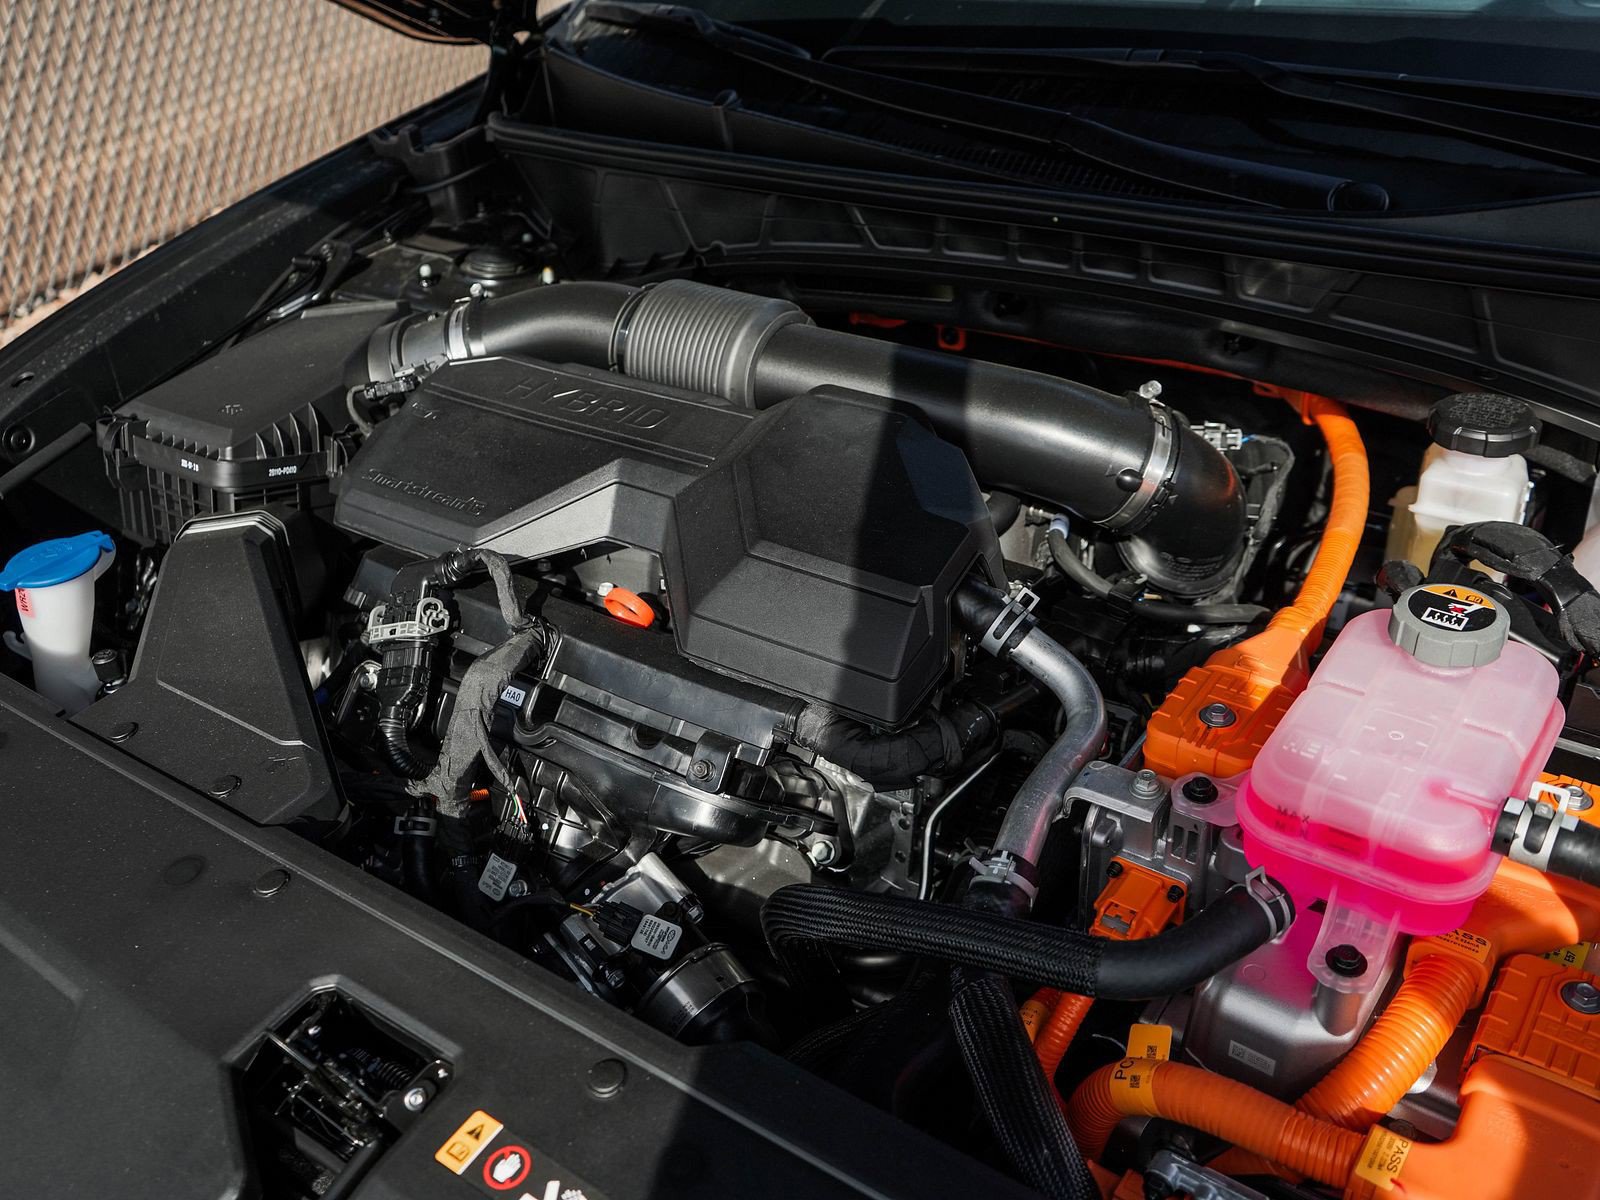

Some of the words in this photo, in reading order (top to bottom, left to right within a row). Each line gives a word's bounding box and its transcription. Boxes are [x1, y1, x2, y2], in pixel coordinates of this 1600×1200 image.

[505, 377, 671, 430] HYBRID
[1276, 805, 1310, 825] MAX
[1451, 928, 1487, 946] ASS
[1386, 1138, 1409, 1173] PASS
